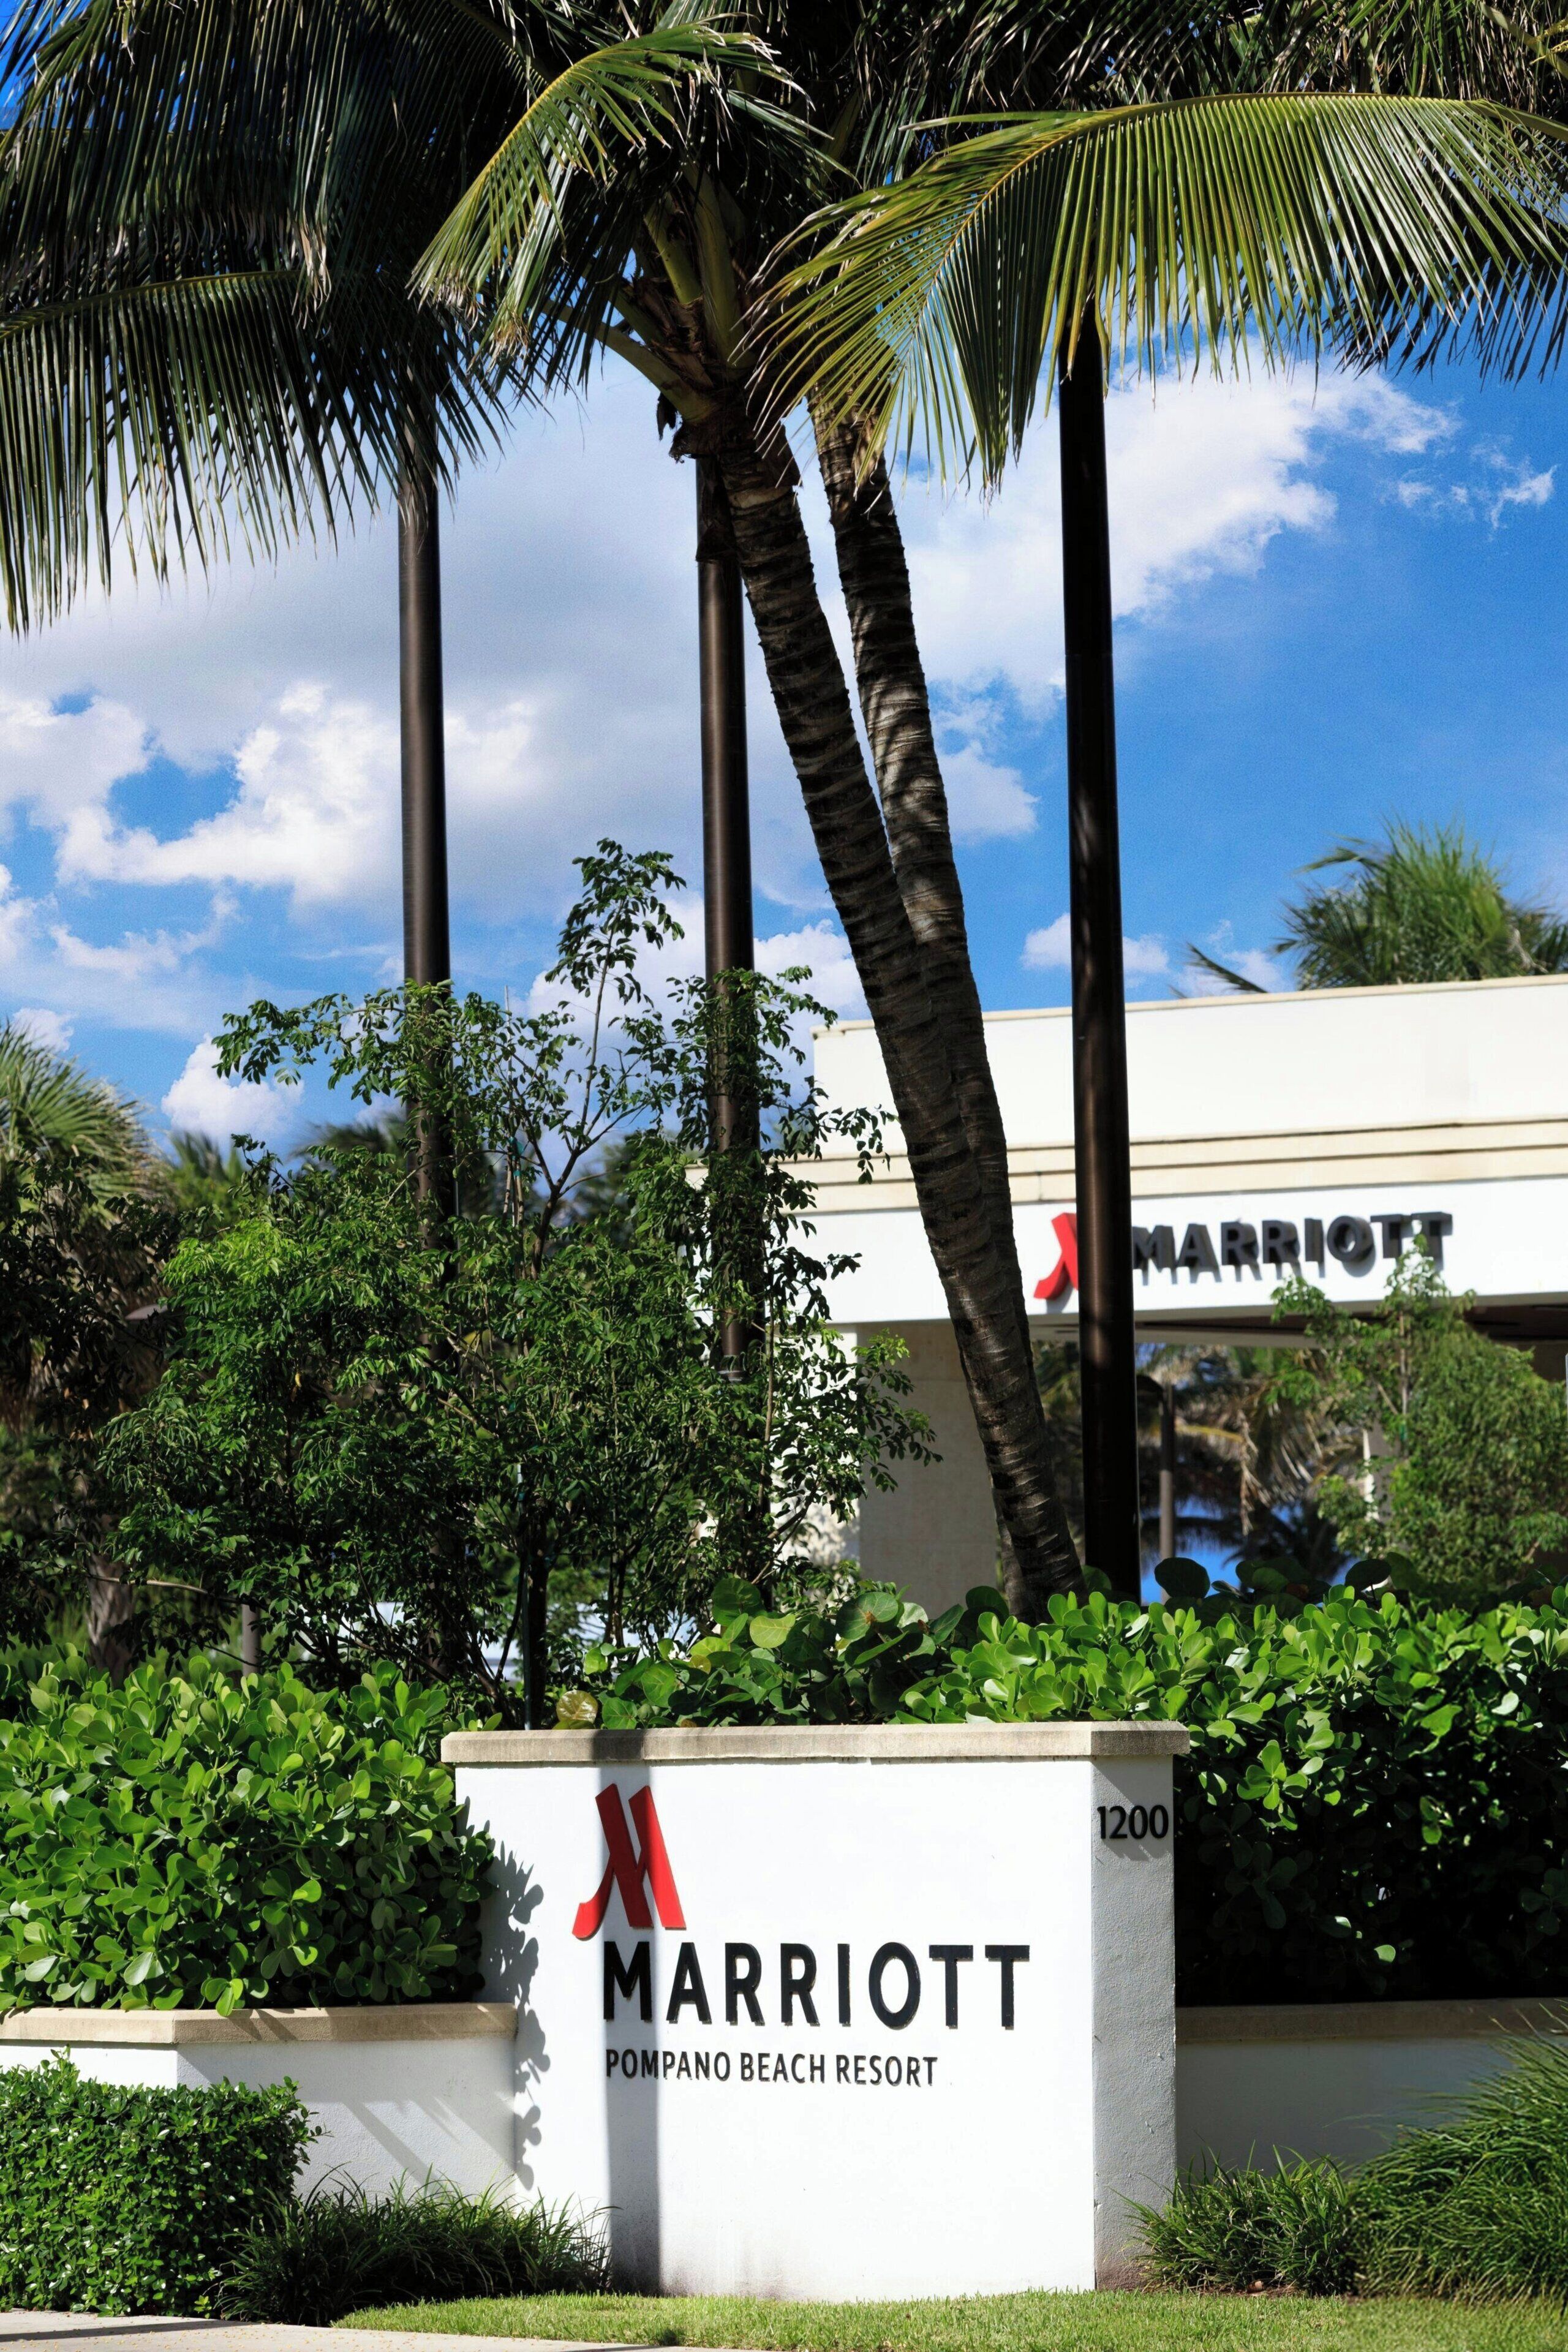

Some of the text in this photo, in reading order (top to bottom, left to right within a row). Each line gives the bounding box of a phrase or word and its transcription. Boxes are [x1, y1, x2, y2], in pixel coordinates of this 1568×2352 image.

[1133, 1212, 1452, 1272] MARRIOTT
[1097, 1804, 1169, 1839] 1200
[603, 1940, 1030, 2030] MARRIOTT
[606, 2049, 938, 2087] POMPANO BEACH RESORT
